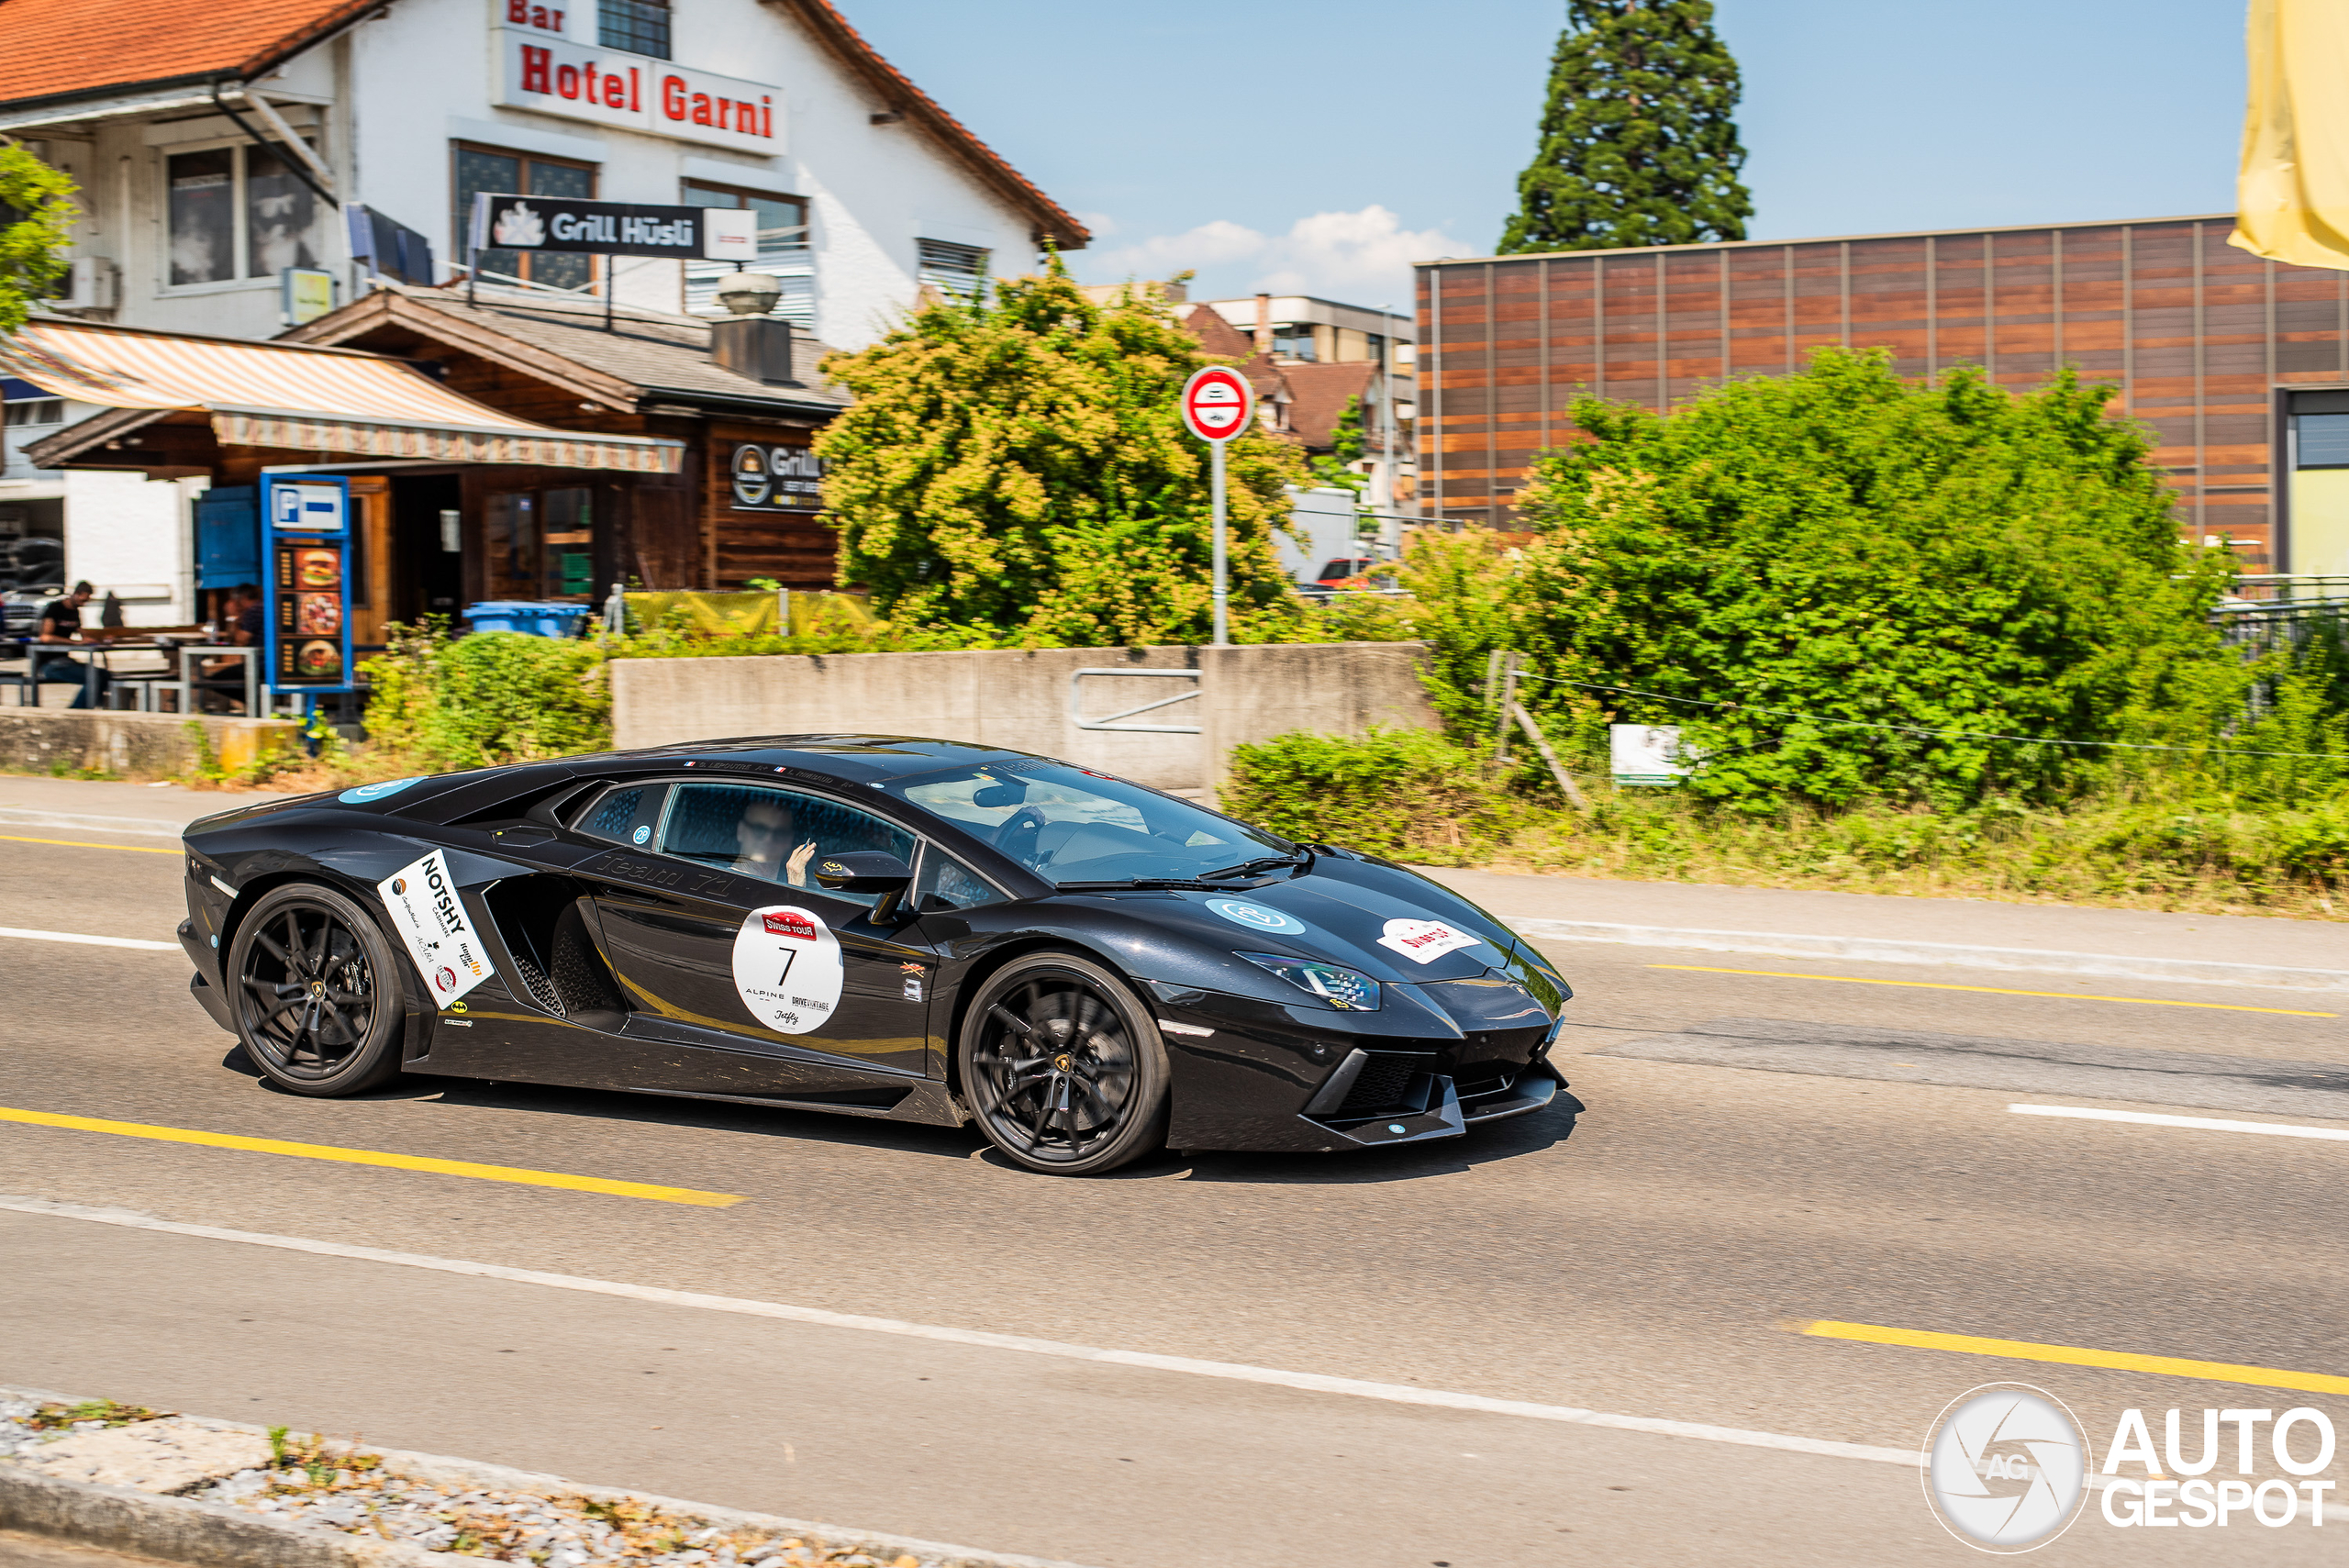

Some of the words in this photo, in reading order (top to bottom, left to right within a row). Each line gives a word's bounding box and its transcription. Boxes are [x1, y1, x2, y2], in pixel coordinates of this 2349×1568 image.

[507, 0, 565, 32] Bar
[520, 44, 640, 112] Hotel
[662, 74, 773, 138] Garni
[551, 213, 617, 243] Grill
[620, 217, 694, 247] Hüsli
[279, 491, 298, 521] P
[635, 829, 649, 840] 2P
[596, 855, 685, 886] Team
[690, 873, 737, 897] 71
[421, 857, 465, 934] NOTSHY
[431, 906, 451, 938] CASHMERE
[765, 918, 791, 932] SWISS
[793, 926, 813, 937] TOUR
[415, 935, 435, 963] ACABA
[778, 946, 797, 986] 7
[745, 988, 785, 1000] ALPINE
[774, 1009, 799, 1026] Jetfly
